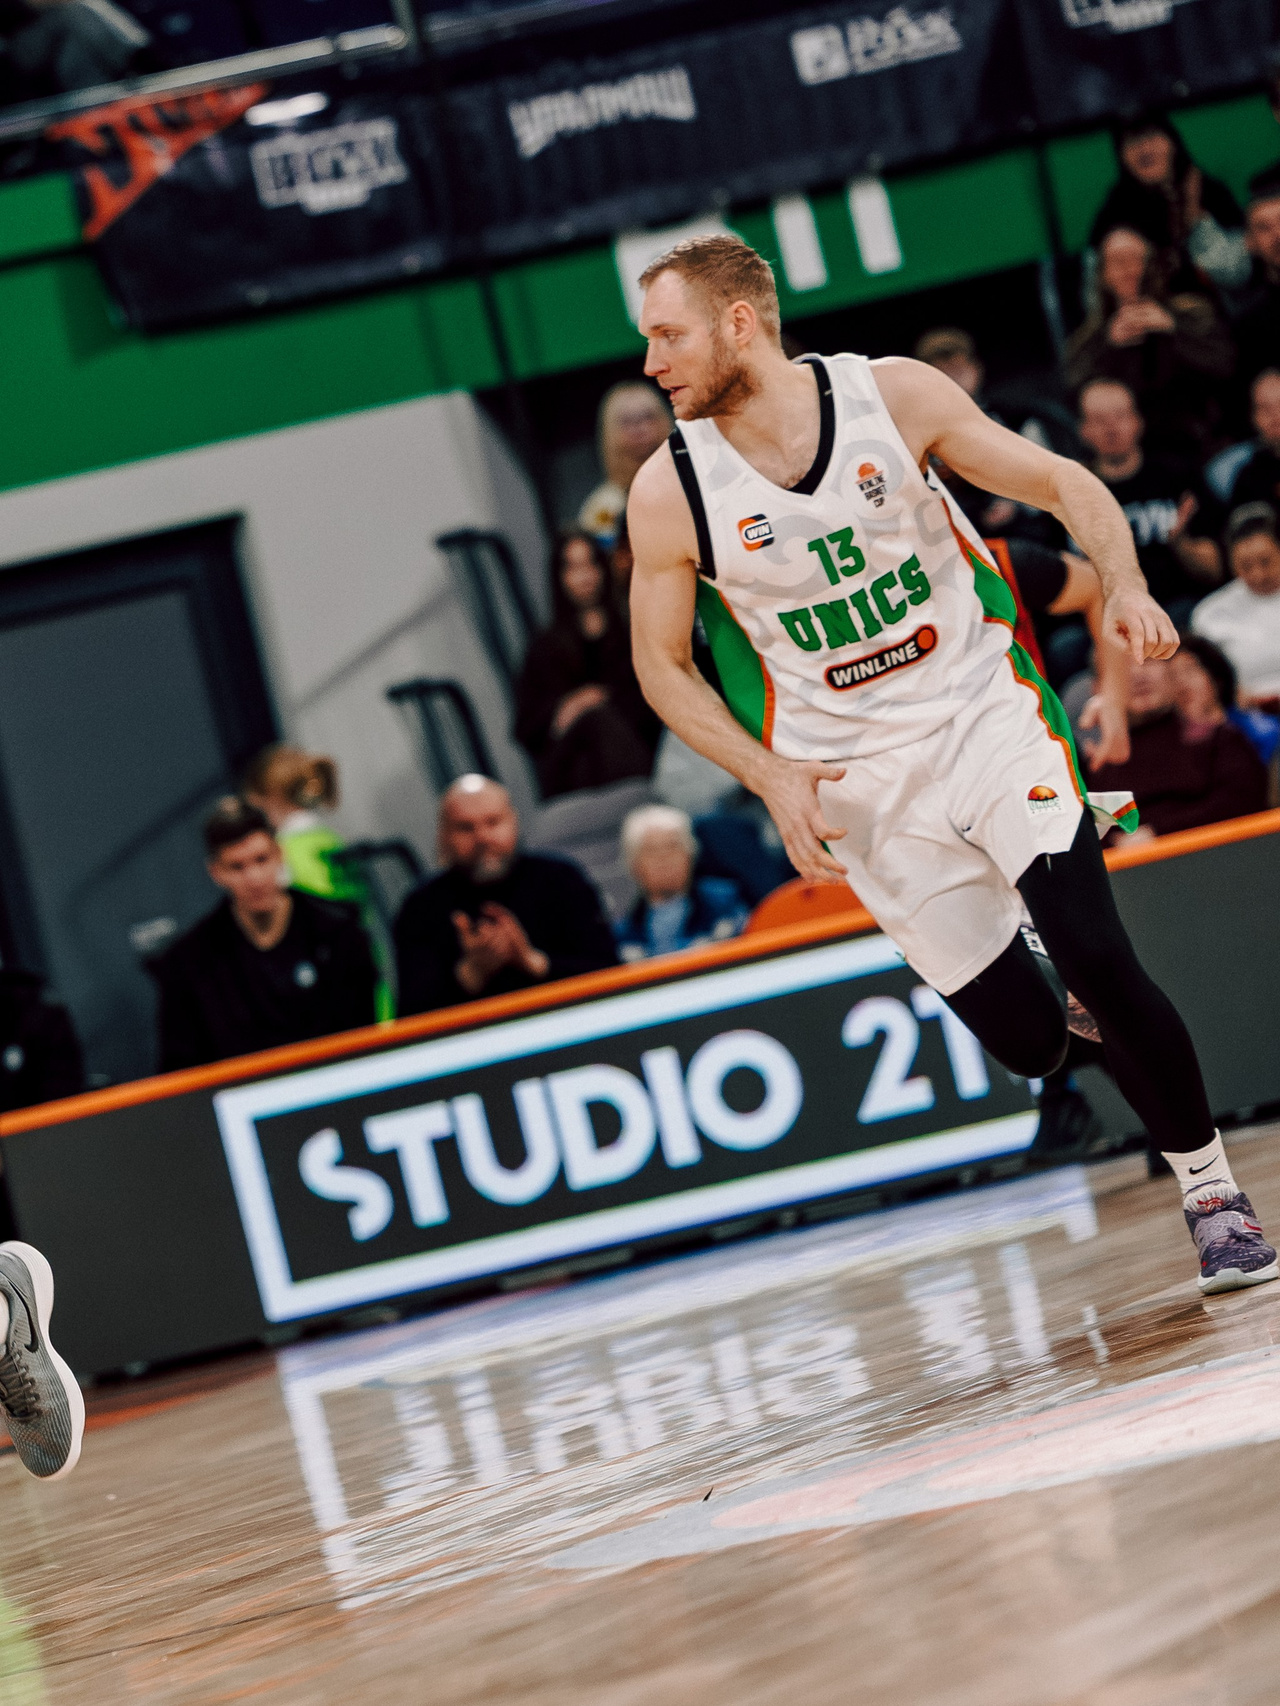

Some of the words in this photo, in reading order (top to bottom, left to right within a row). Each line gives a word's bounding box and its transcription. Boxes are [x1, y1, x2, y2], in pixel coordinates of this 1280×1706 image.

[746, 523, 771, 540] WIN
[808, 526, 866, 586] 13
[778, 553, 931, 652] UNICS
[832, 640, 919, 688] WINLINE
[298, 1028, 804, 1241] STUDIO
[841, 985, 991, 1124] 21
